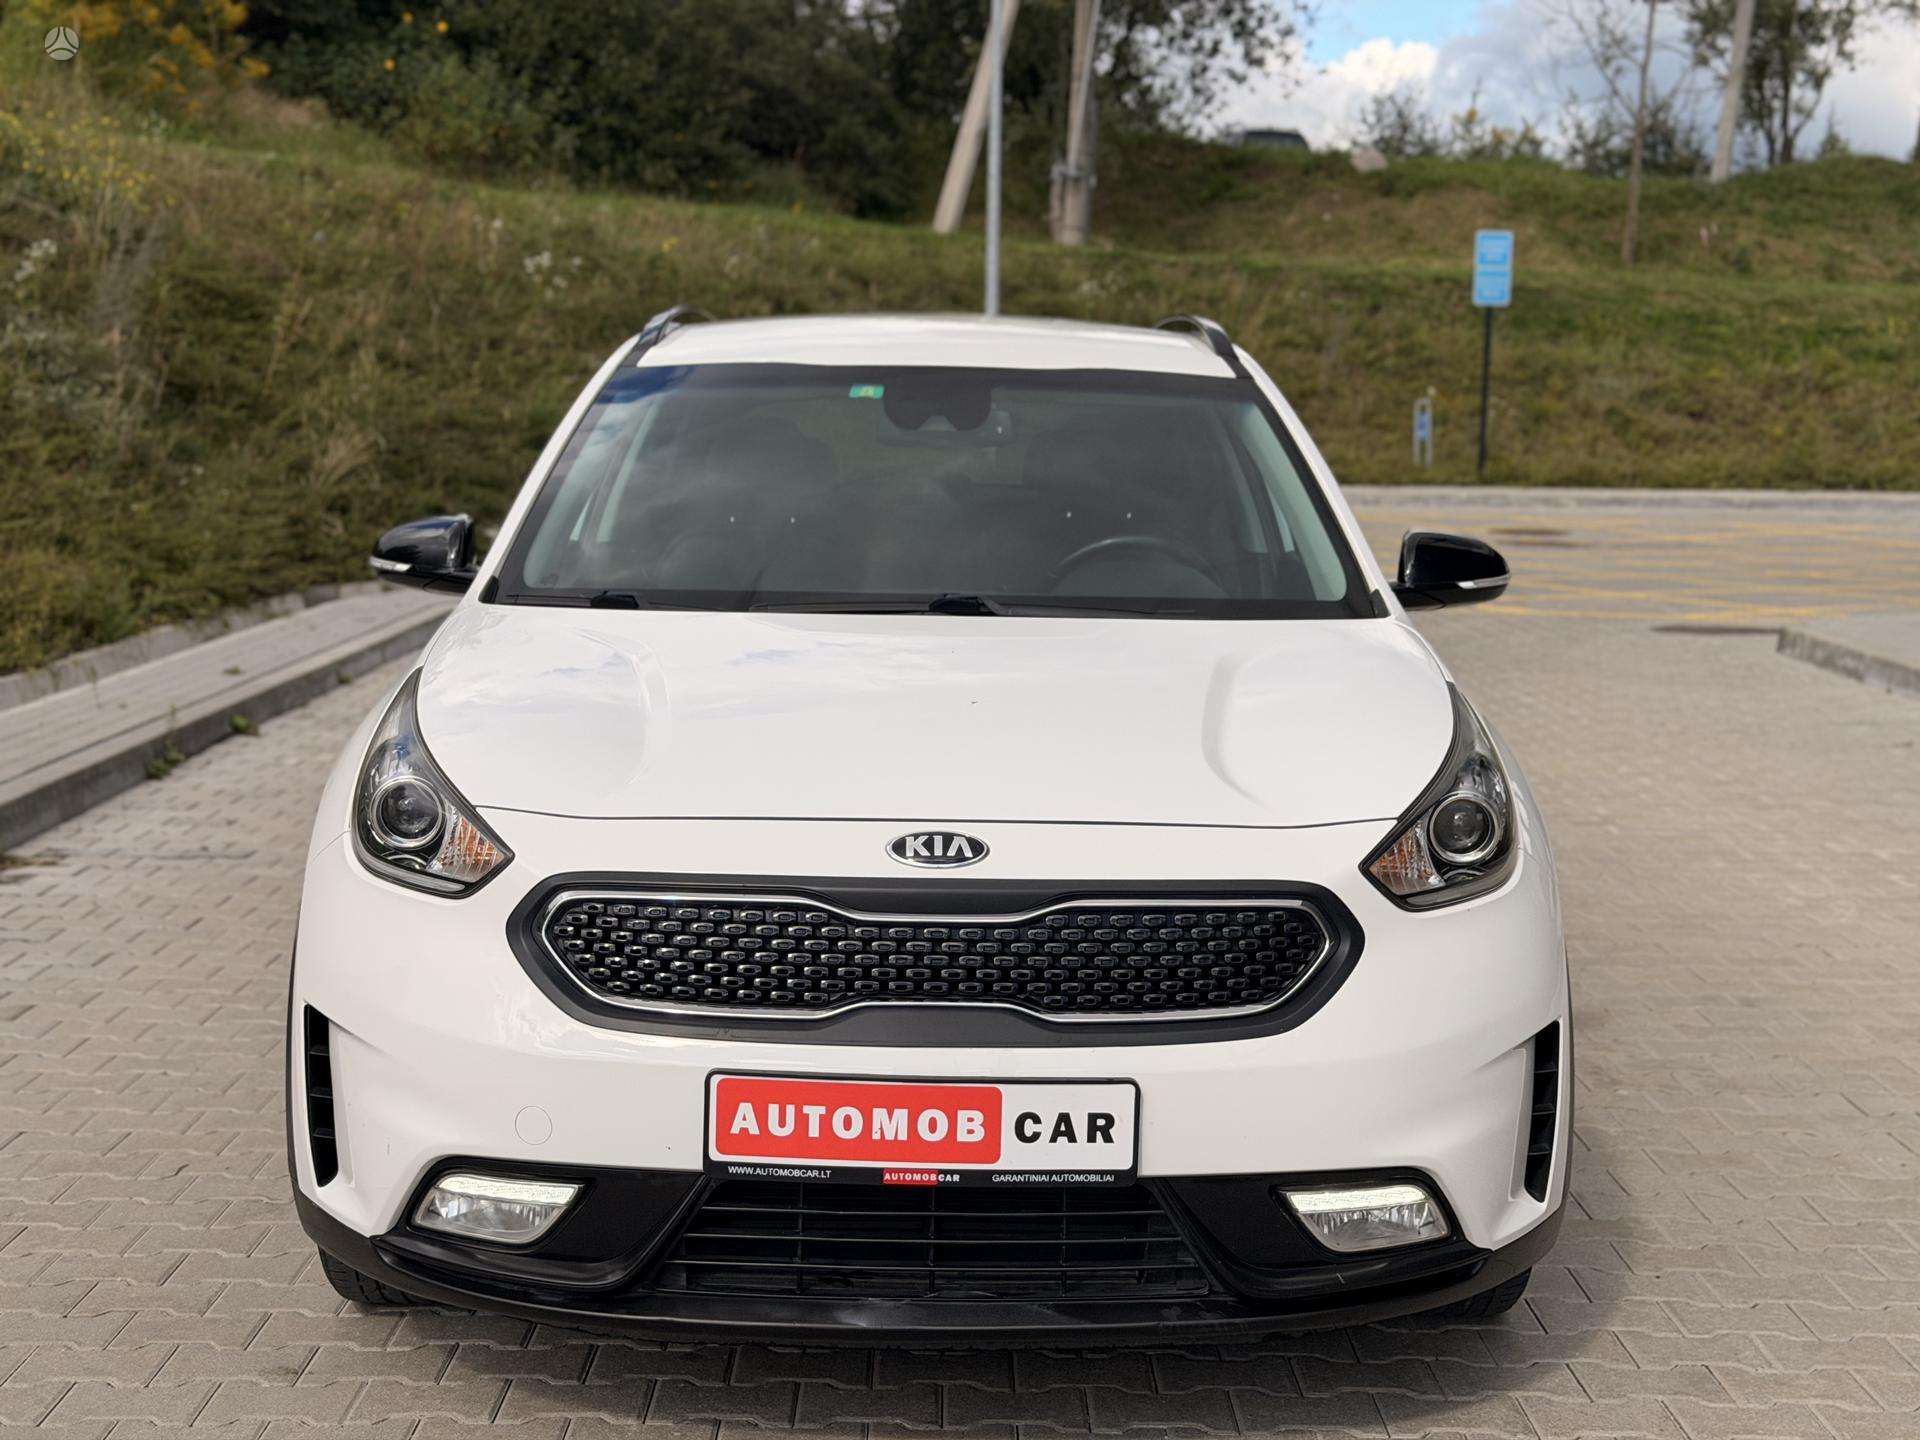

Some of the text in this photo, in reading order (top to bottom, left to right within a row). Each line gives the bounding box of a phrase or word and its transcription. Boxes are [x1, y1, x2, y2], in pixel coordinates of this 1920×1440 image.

[905, 835, 974, 858] KIA
[729, 1102, 1116, 1144] AUTOMOB CAR
[727, 1165, 832, 1179] WWW.AUTOMOBCAR.LT
[991, 1173, 1116, 1183] GARANTINIAI AUTOMOBILIAI
